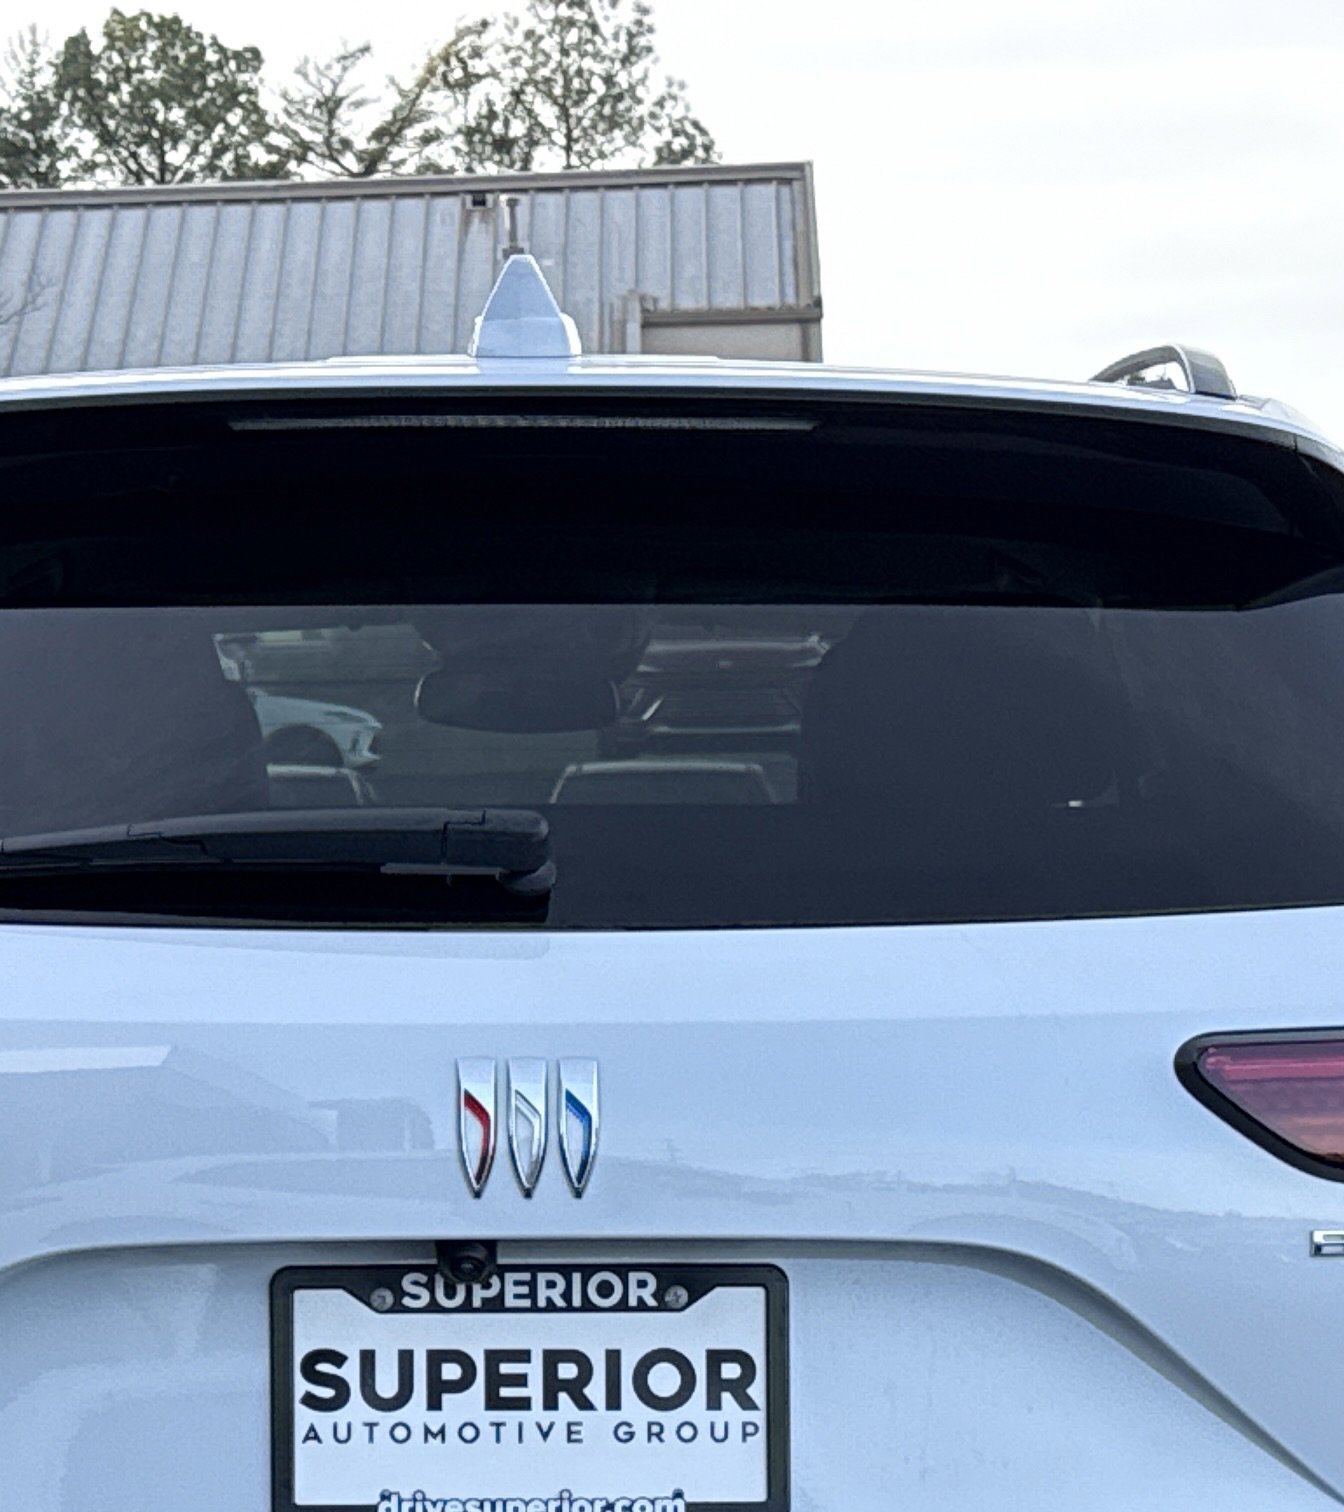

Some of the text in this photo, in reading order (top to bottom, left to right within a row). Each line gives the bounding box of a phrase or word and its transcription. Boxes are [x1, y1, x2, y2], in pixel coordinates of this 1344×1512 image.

[400, 1270, 659, 1309] SUPERIOR
[299, 1347, 761, 1412] SUPERIOR
[301, 1420, 760, 1444] AUTOMOTIVE GROUP
